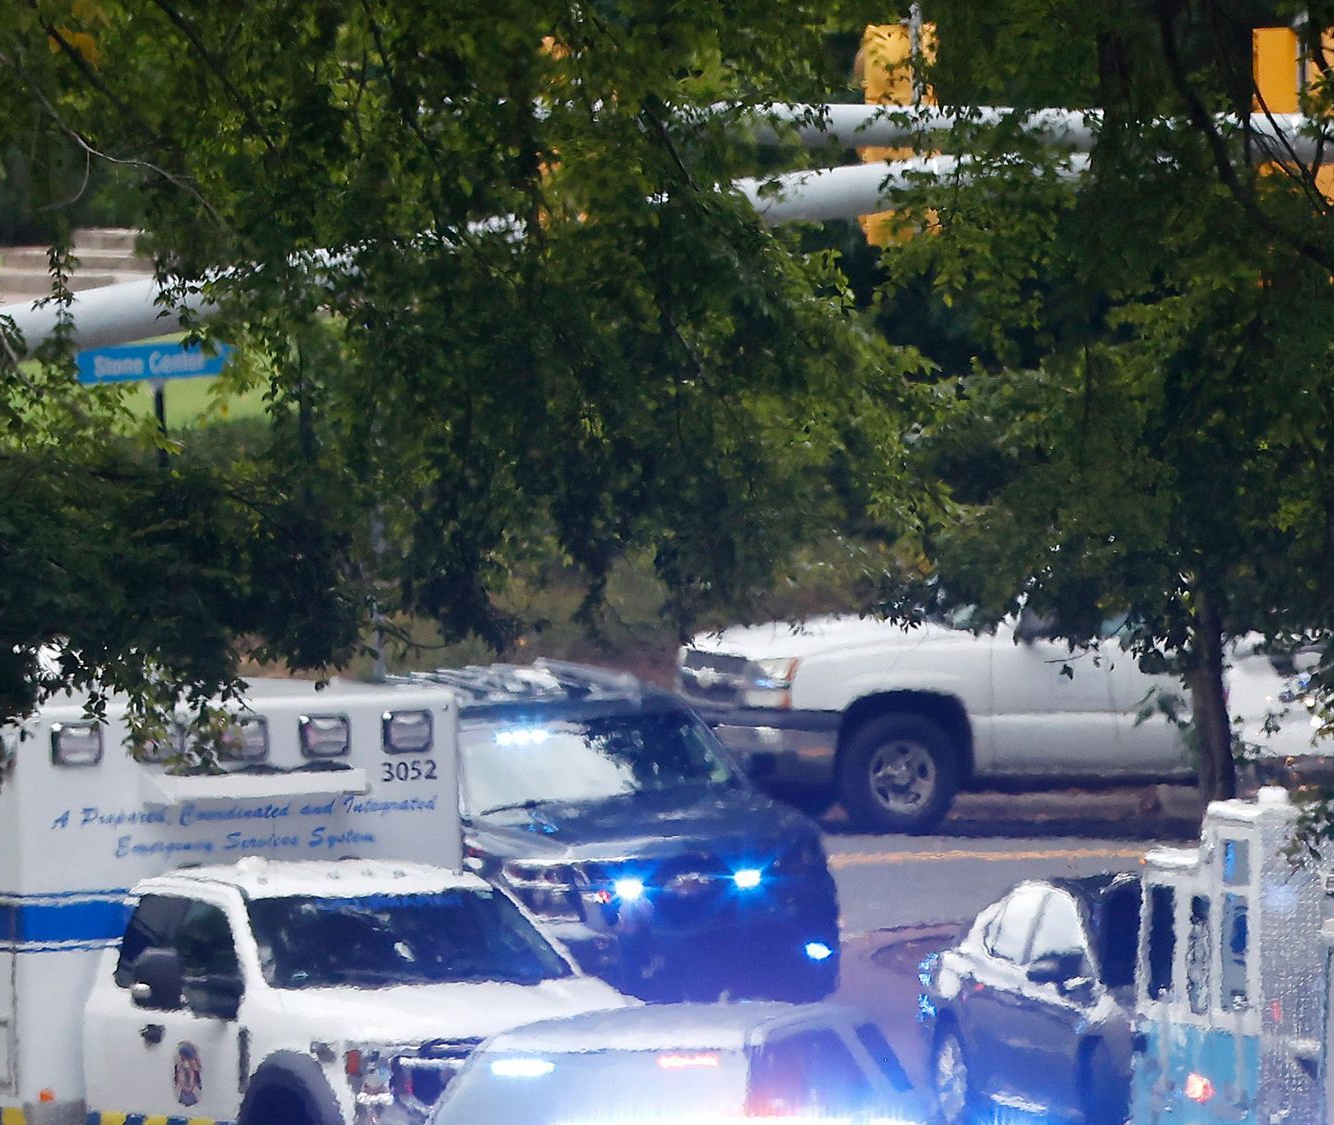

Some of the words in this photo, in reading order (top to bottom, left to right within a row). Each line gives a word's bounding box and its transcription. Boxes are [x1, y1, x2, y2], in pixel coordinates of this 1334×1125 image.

[381, 759, 438, 782] 3052
[52, 810, 70, 829] A
[300, 799, 335, 815] and
[343, 795, 439, 816] Integrated
[224, 831, 299, 849] Services
[308, 827, 376, 848] System
